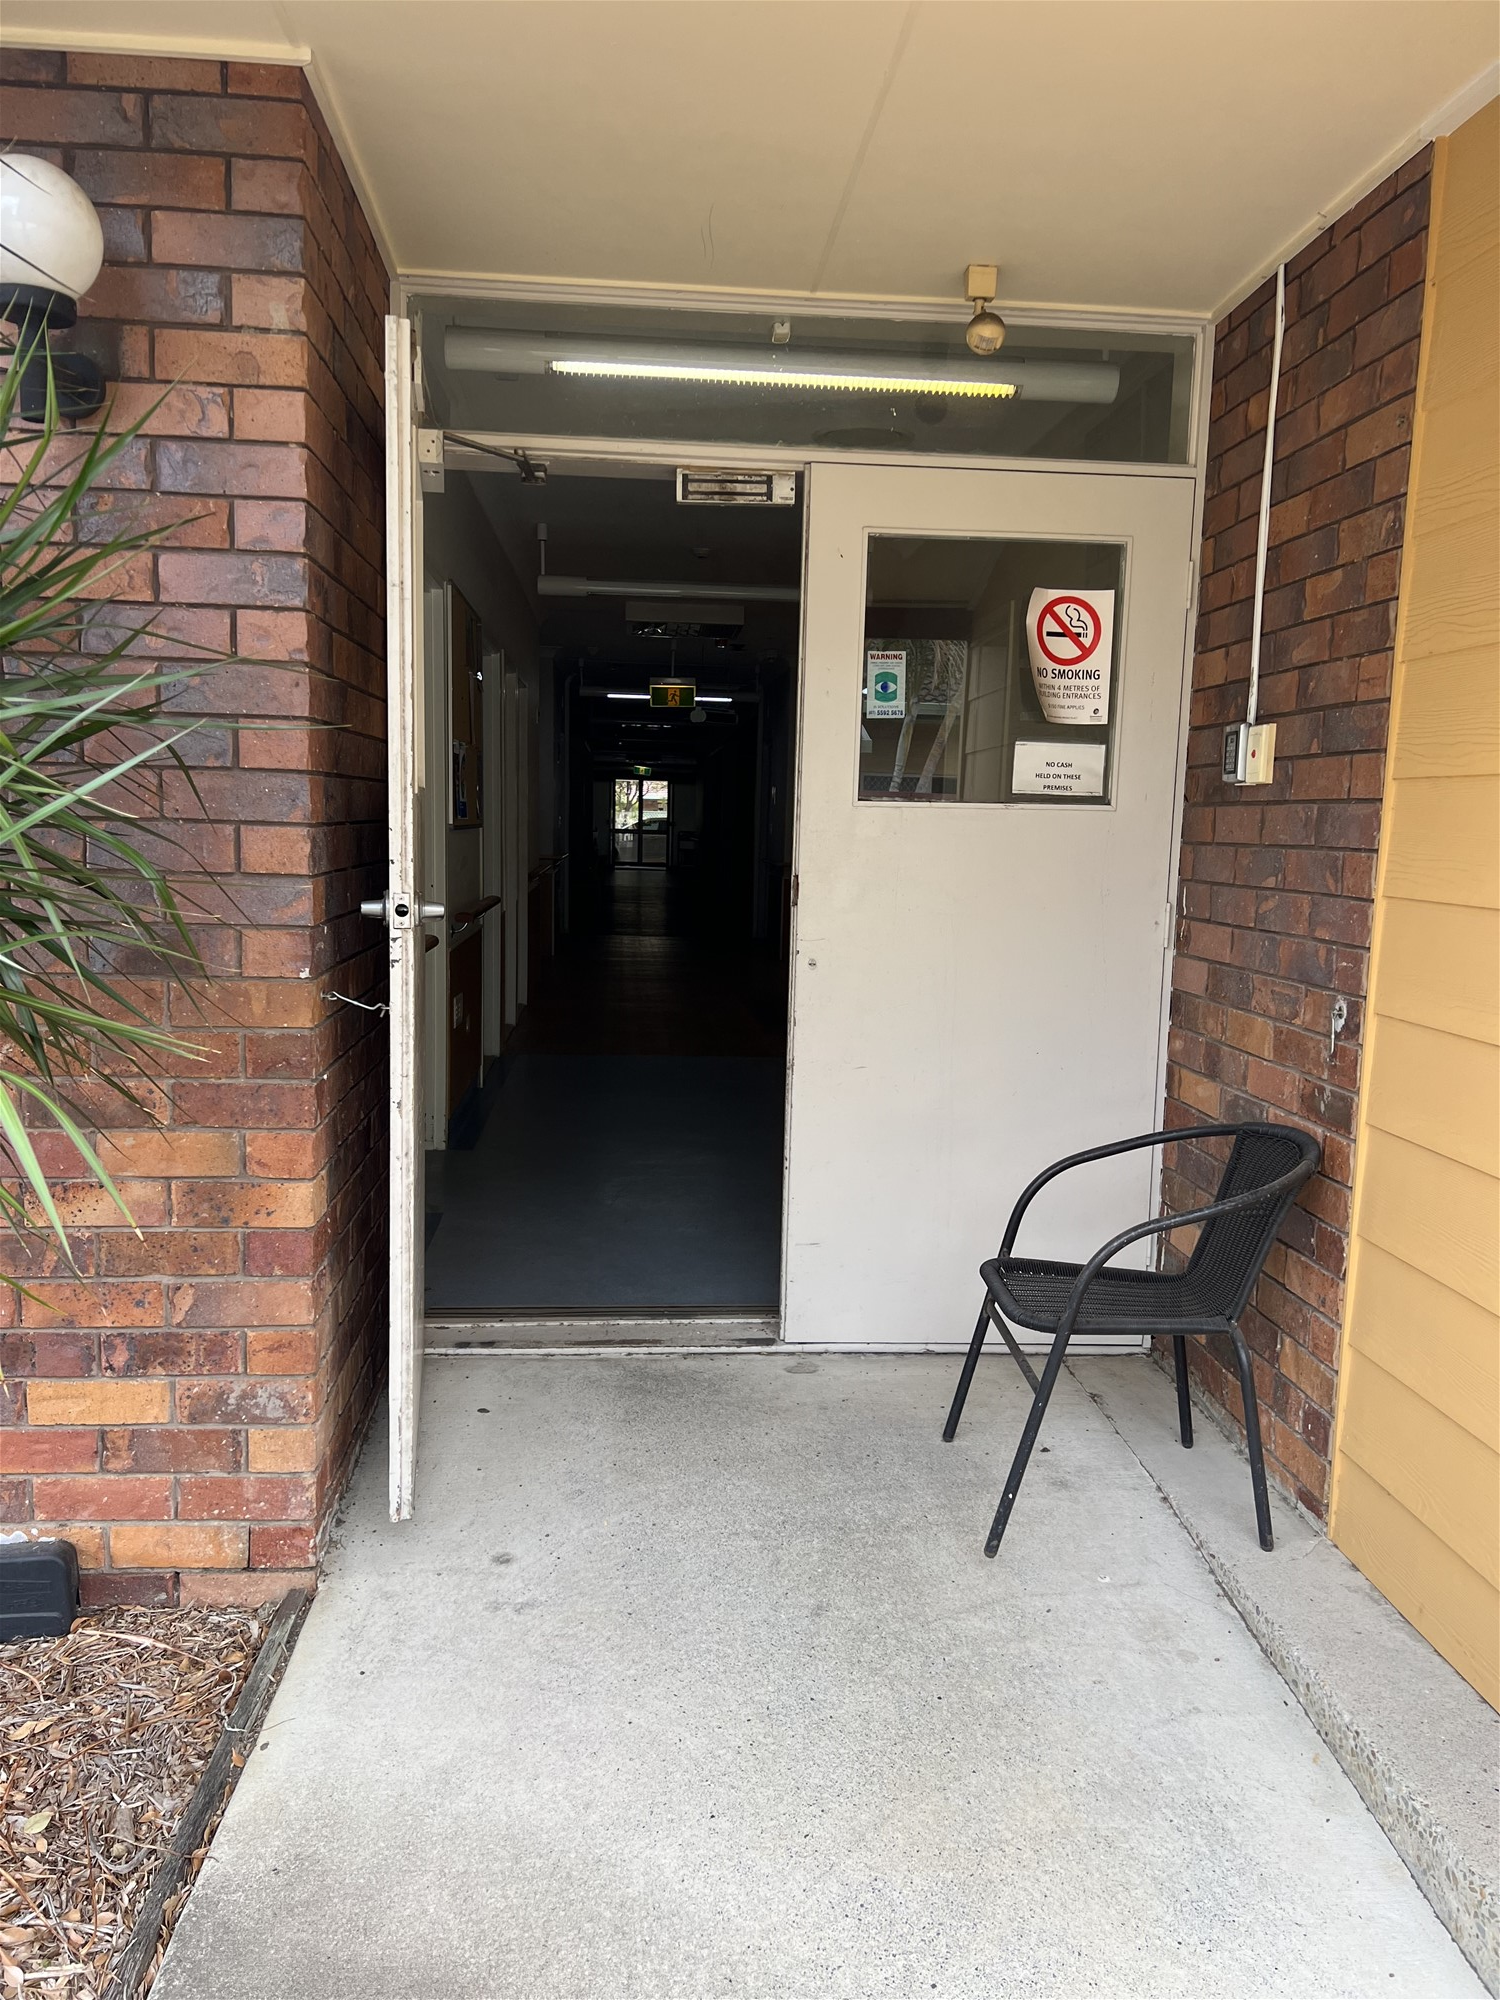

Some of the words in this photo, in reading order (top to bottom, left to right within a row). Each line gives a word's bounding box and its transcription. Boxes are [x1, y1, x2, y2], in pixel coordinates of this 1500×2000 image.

[1036, 667, 1048, 678] NO
[1051, 668, 1100, 680] SMOKING
[1062, 692, 1102, 700] ENTRANCES
[1043, 784, 1073, 792] PREMISES
